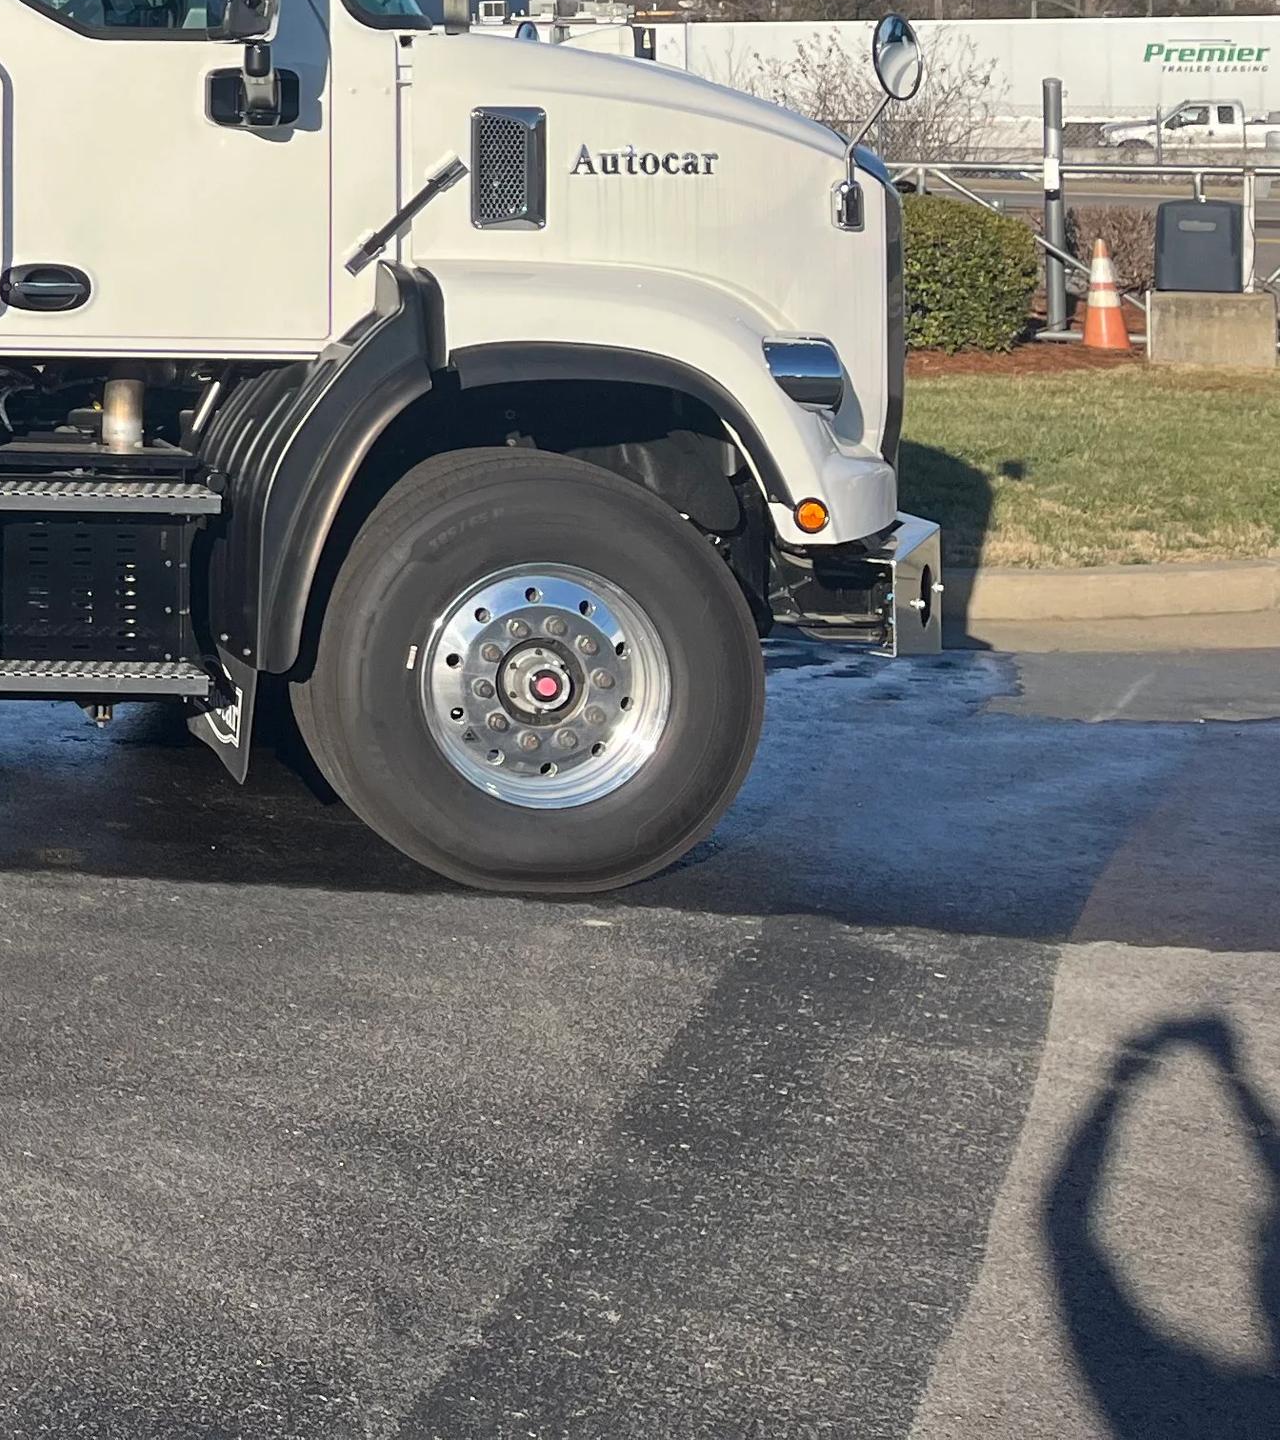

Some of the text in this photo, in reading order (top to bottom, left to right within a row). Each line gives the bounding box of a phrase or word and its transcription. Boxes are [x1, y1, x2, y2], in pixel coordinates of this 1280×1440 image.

[1143, 43, 1271, 63] Premier
[1161, 64, 1269, 73] TRAILER LEASING
[570, 143, 719, 175] Autocar
